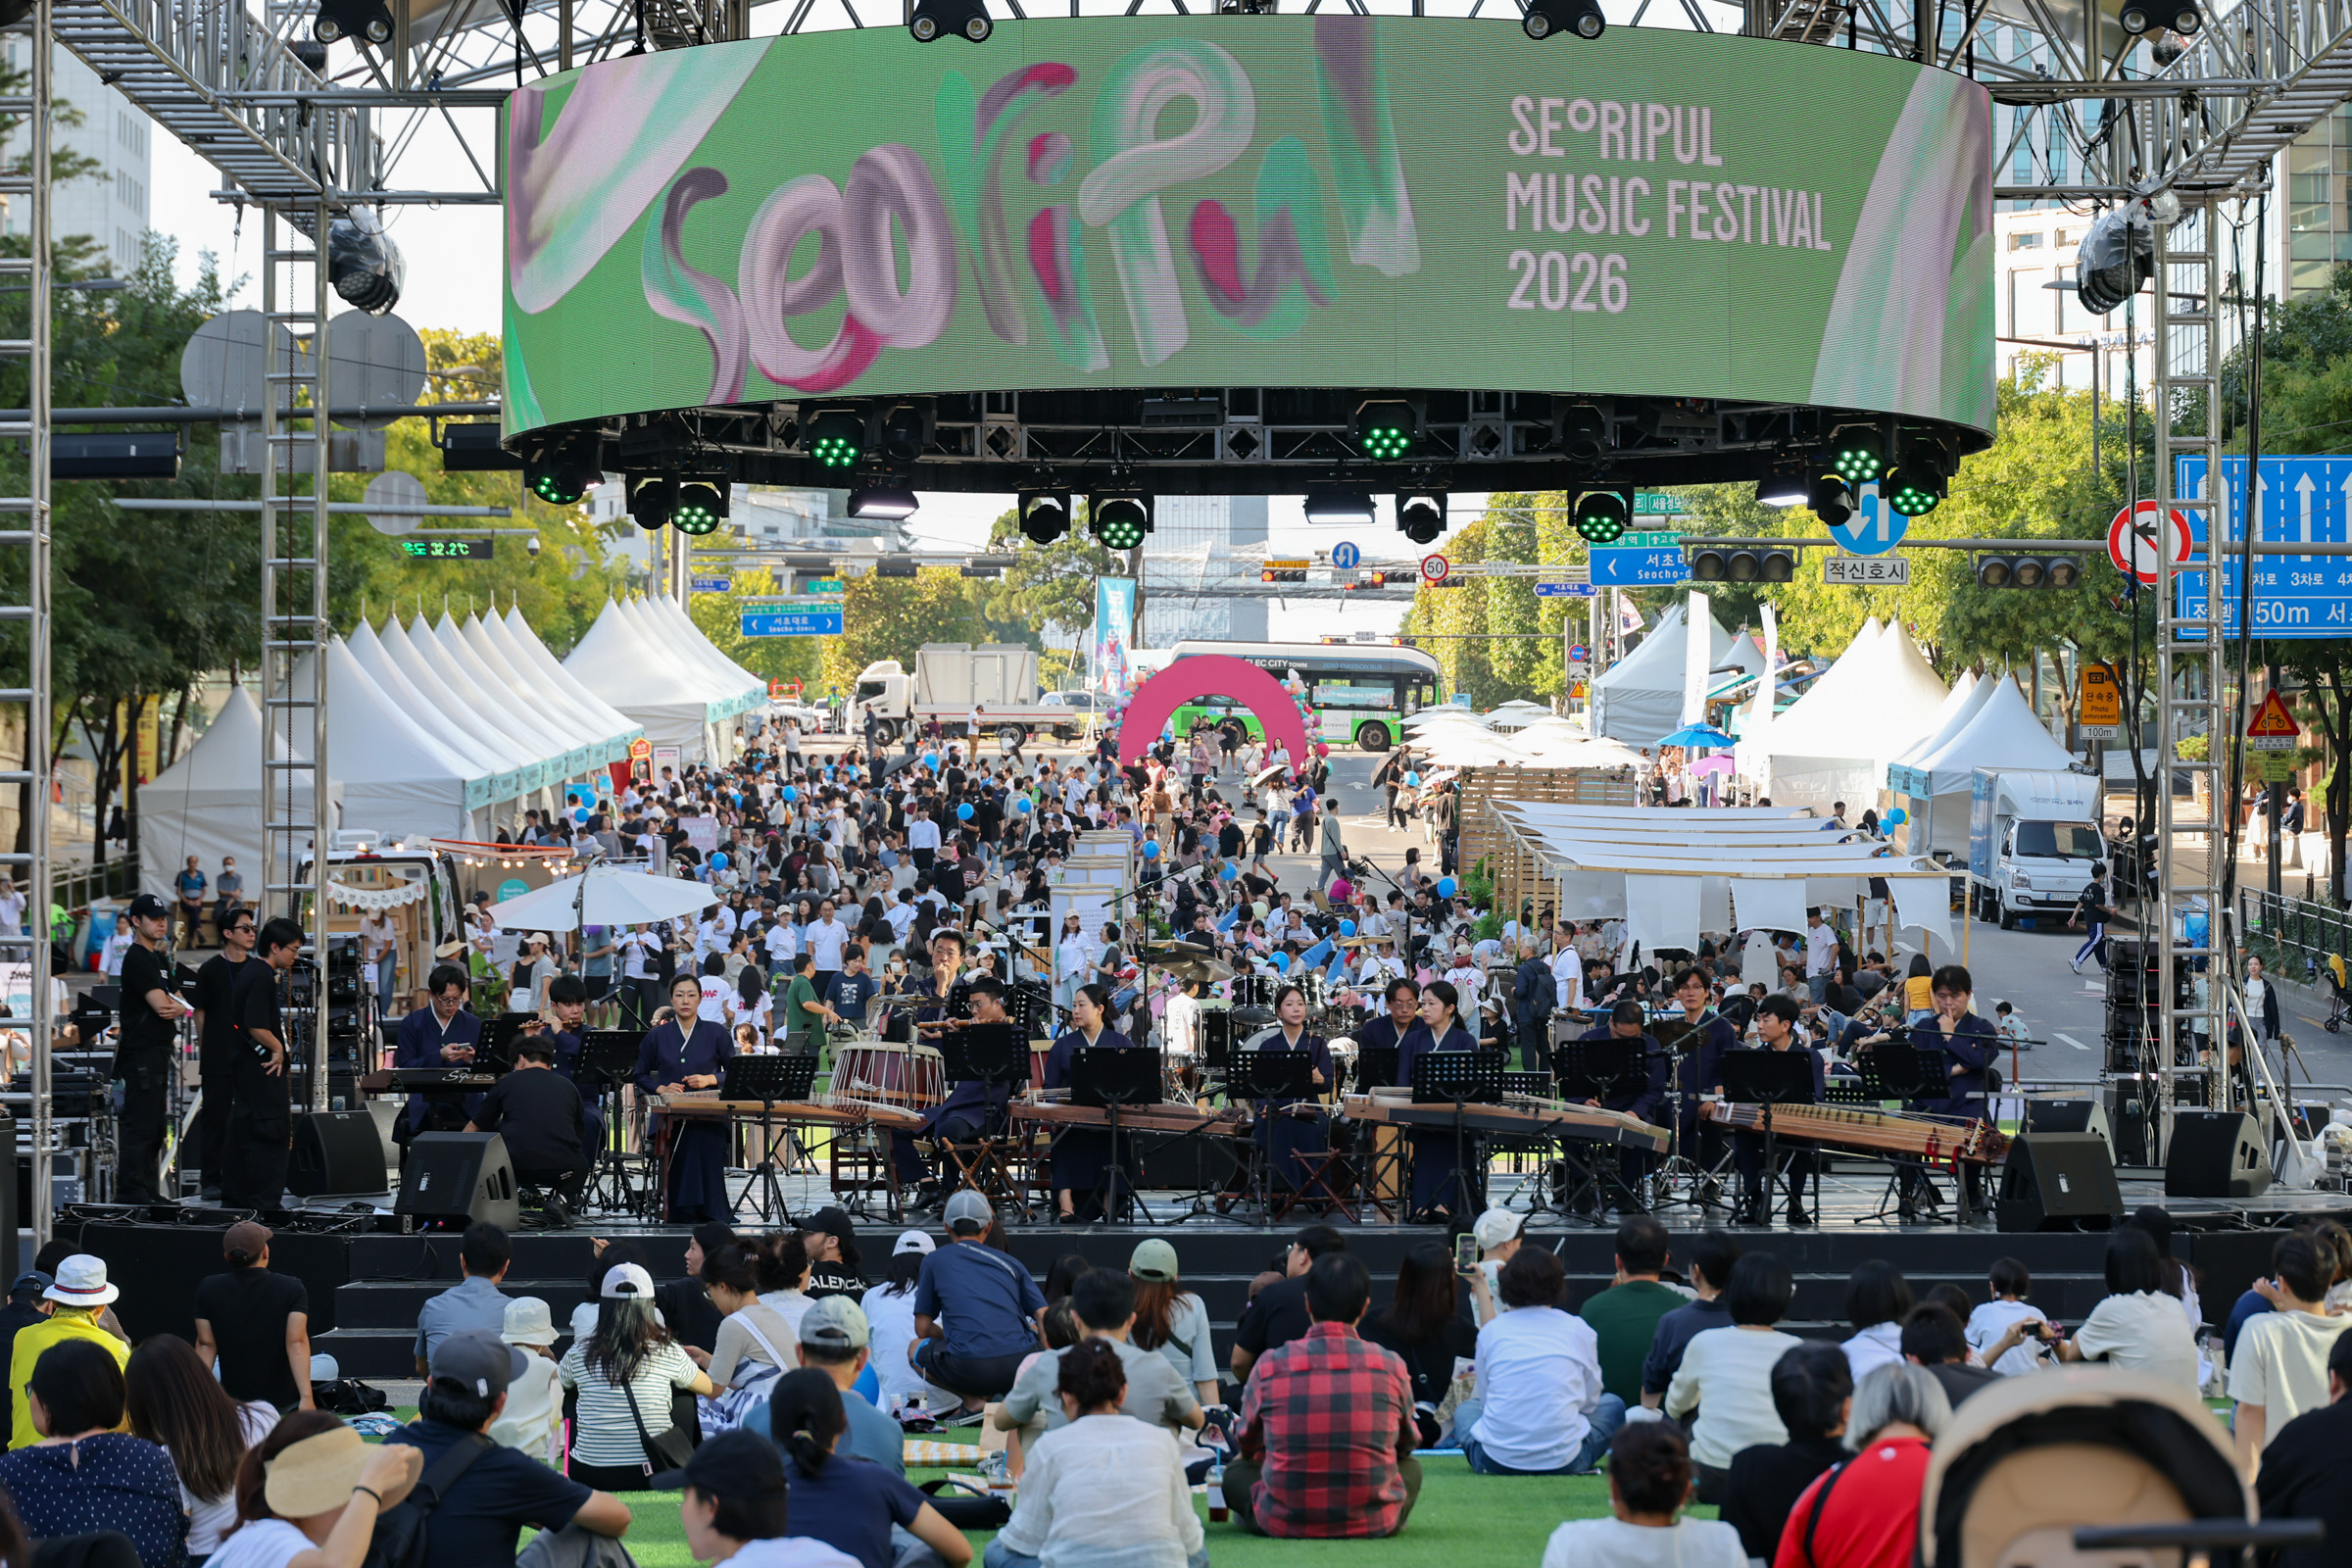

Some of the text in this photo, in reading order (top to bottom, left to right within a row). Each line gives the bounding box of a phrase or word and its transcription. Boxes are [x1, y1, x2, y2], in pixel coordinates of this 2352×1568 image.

[1508, 95, 1723, 166] SEORIPUL
[1506, 172, 1833, 251] MUSIC FESTIVAL
[1507, 249, 1629, 314] 2026
[1427, 562, 1444, 574] 50
[1638, 570, 1691, 579] Seocho-d
[1829, 562, 1904, 580] 적신호시
[2253, 573, 2278, 586] 차로
[2290, 572, 2324, 586] 3차로
[2255, 601, 2310, 623] 50m
[2327, 602, 2352, 623] 서
[2085, 691, 2114, 703] 단속중
[2087, 728, 2112, 737] 100m
